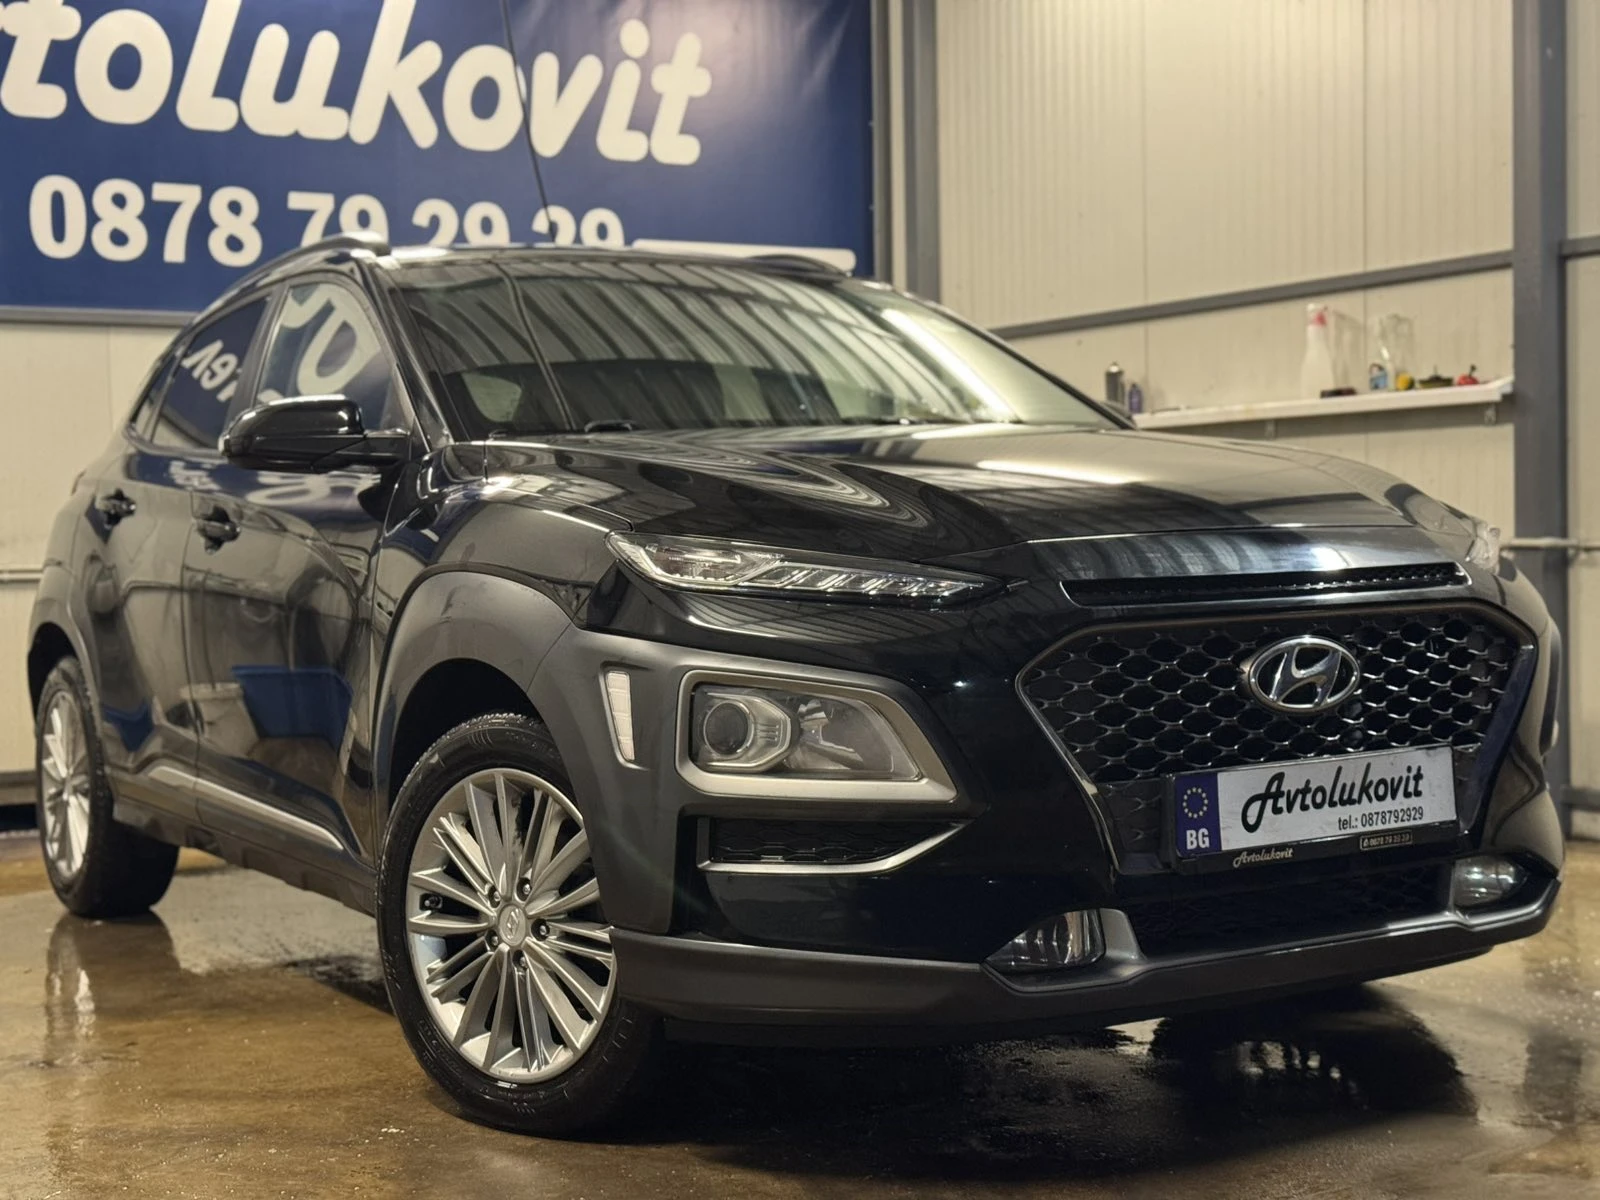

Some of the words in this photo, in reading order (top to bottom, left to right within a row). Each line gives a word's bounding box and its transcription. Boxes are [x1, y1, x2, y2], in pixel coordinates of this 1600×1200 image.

[0, 0, 713, 166] tolukovit
[29, 174, 263, 267] 0878
[1240, 761, 1424, 834] Avtolukovit
[1337, 815, 1359, 831] tel.:
[1360, 806, 1424, 828] 0878792929
[1186, 828, 1210, 850] BG
